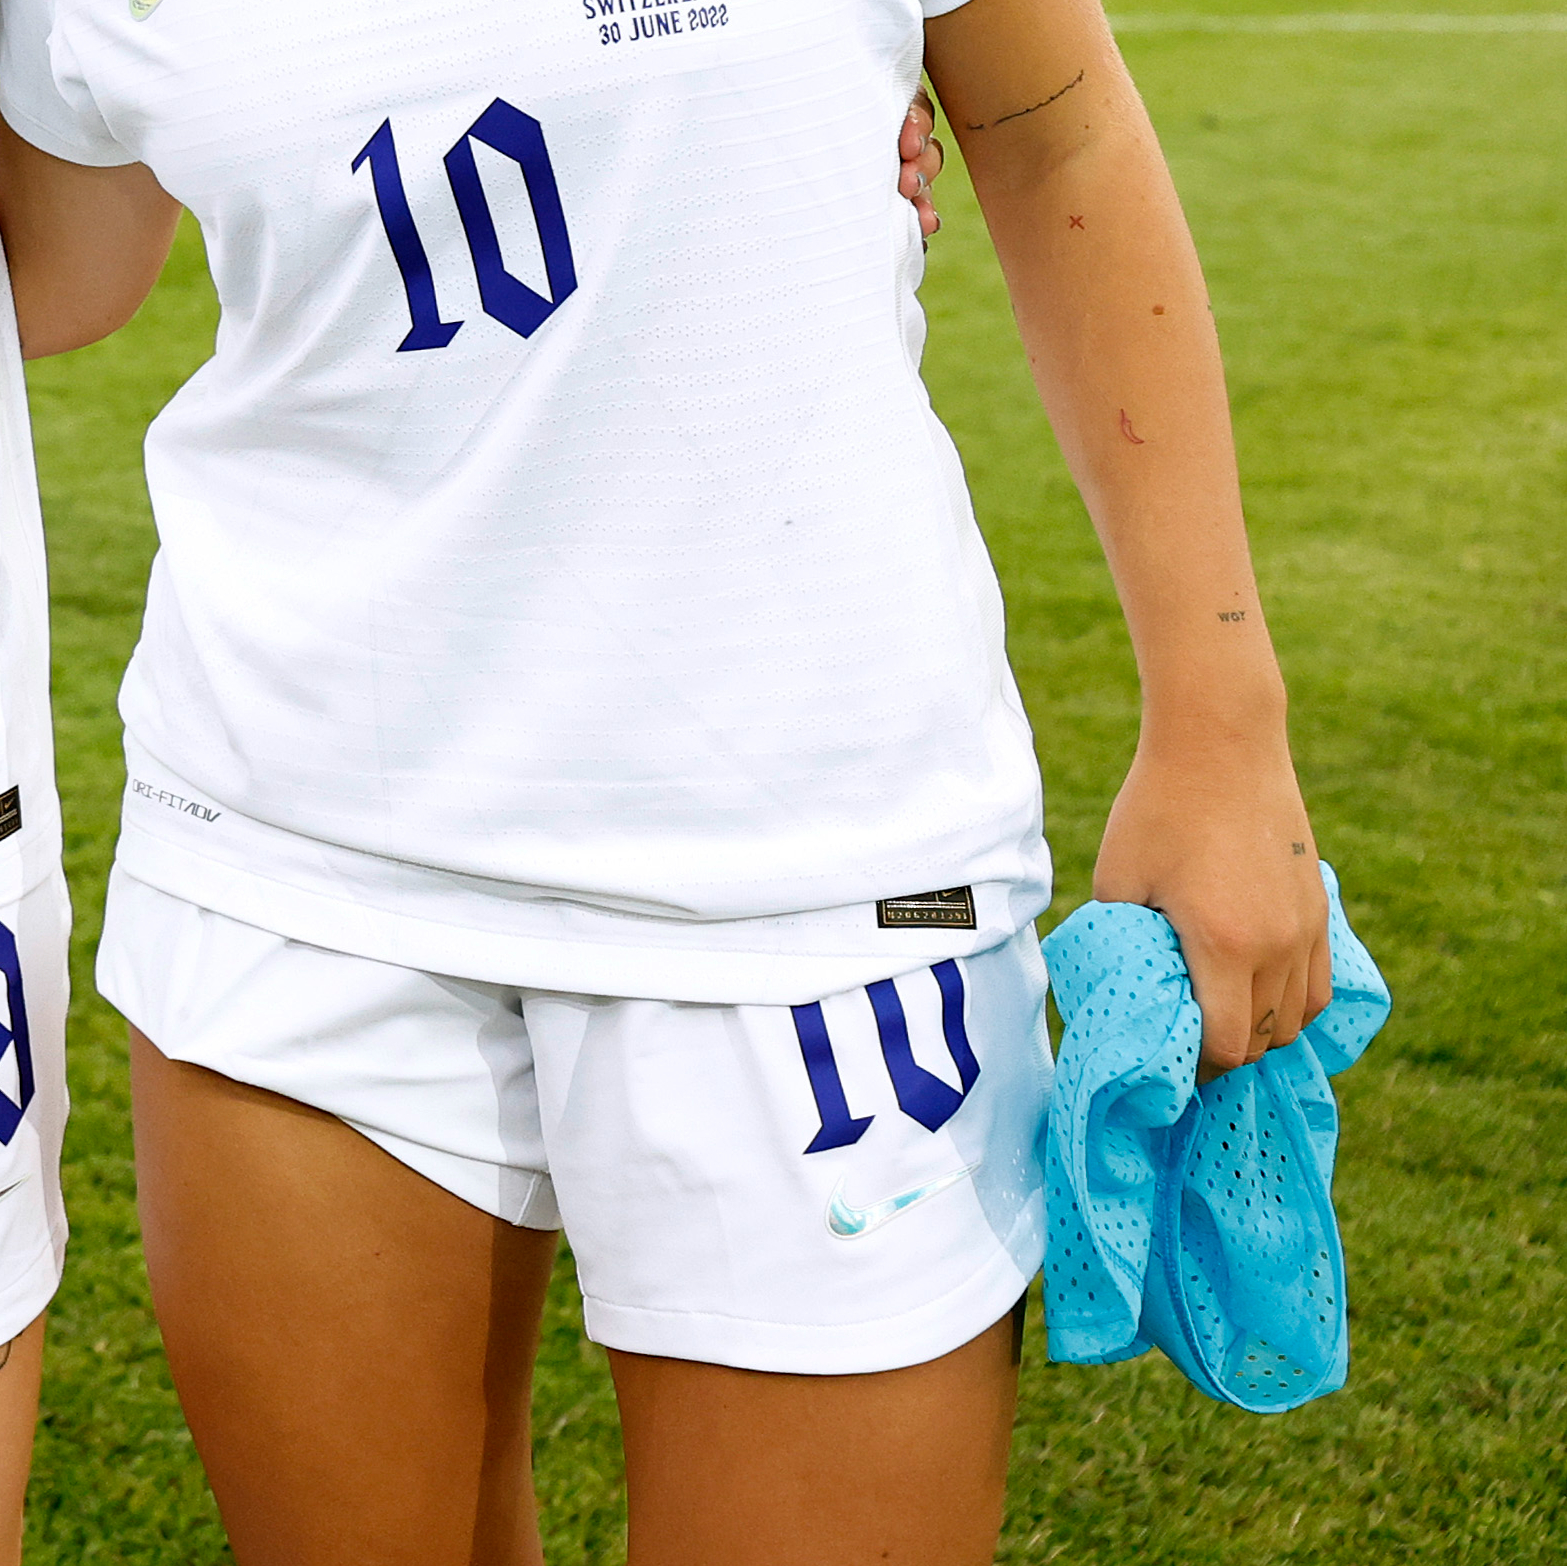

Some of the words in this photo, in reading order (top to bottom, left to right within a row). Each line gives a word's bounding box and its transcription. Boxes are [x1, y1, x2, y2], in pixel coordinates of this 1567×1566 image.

[599, 22, 621, 46] 30
[629, 11, 683, 41] JUNE
[688, 3, 729, 32] 2022
[351, 97, 578, 352] 10
[790, 957, 982, 1155] 10
